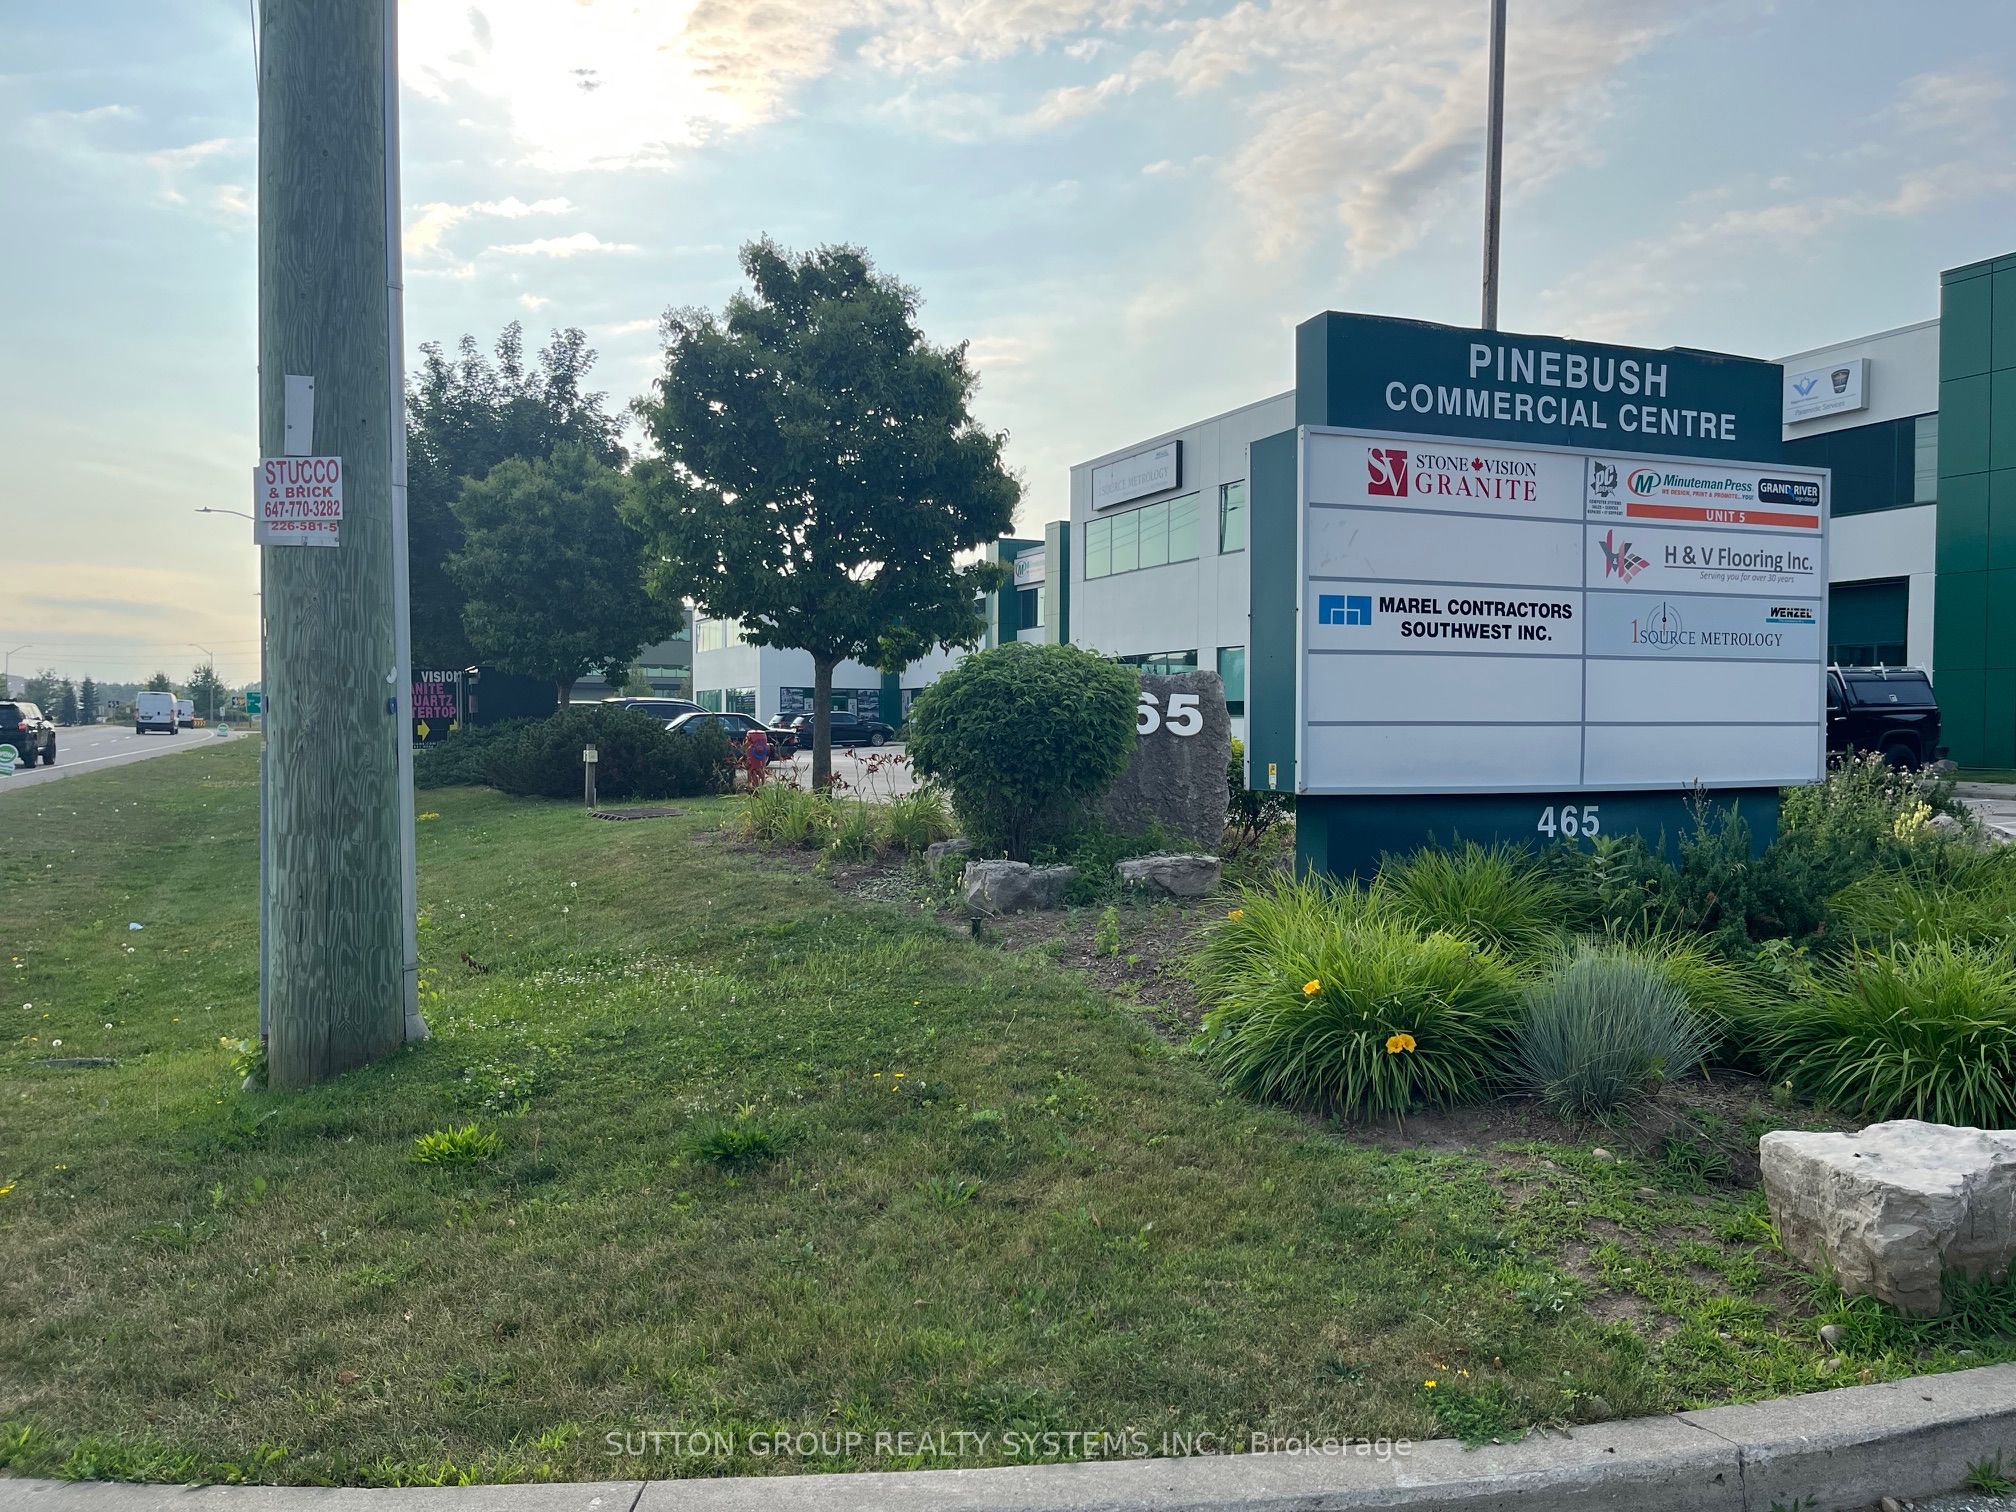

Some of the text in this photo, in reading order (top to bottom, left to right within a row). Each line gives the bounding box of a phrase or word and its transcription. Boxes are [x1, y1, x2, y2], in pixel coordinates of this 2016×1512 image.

[1470, 343, 1667, 397] PINEBUSH
[1386, 381, 1736, 441] COMMERCIAL CENTRE
[265, 459, 339, 485] STUCCO
[1416, 454, 1537, 477] STONE VISION
[269, 486, 333, 498] & BRICK
[1415, 472, 1537, 501] GRANITE
[1664, 474, 1753, 492] Minuteman Press
[1760, 482, 1818, 497] GRAND RIVER
[265, 500, 340, 518] 647-770-3282
[1706, 509, 1746, 523] UNIT 5
[271, 521, 337, 532] 226-581-5
[1664, 545, 1813, 572] H & V Flooring Inc.
[1700, 571, 1725, 582] Serving
[1726, 574, 1739, 582] you
[1740, 572, 1750, 583] for
[1767, 573, 1776, 582] 30
[1777, 575, 1794, 583] years
[1379, 597, 1573, 619] MAREL CONTRACTORS
[1770, 606, 1812, 619] WENZEL
[1401, 620, 1552, 641] SOUTHWEST INC.
[1701, 631, 1783, 647] METROLOGY
[1537, 804, 1600, 838] 465
